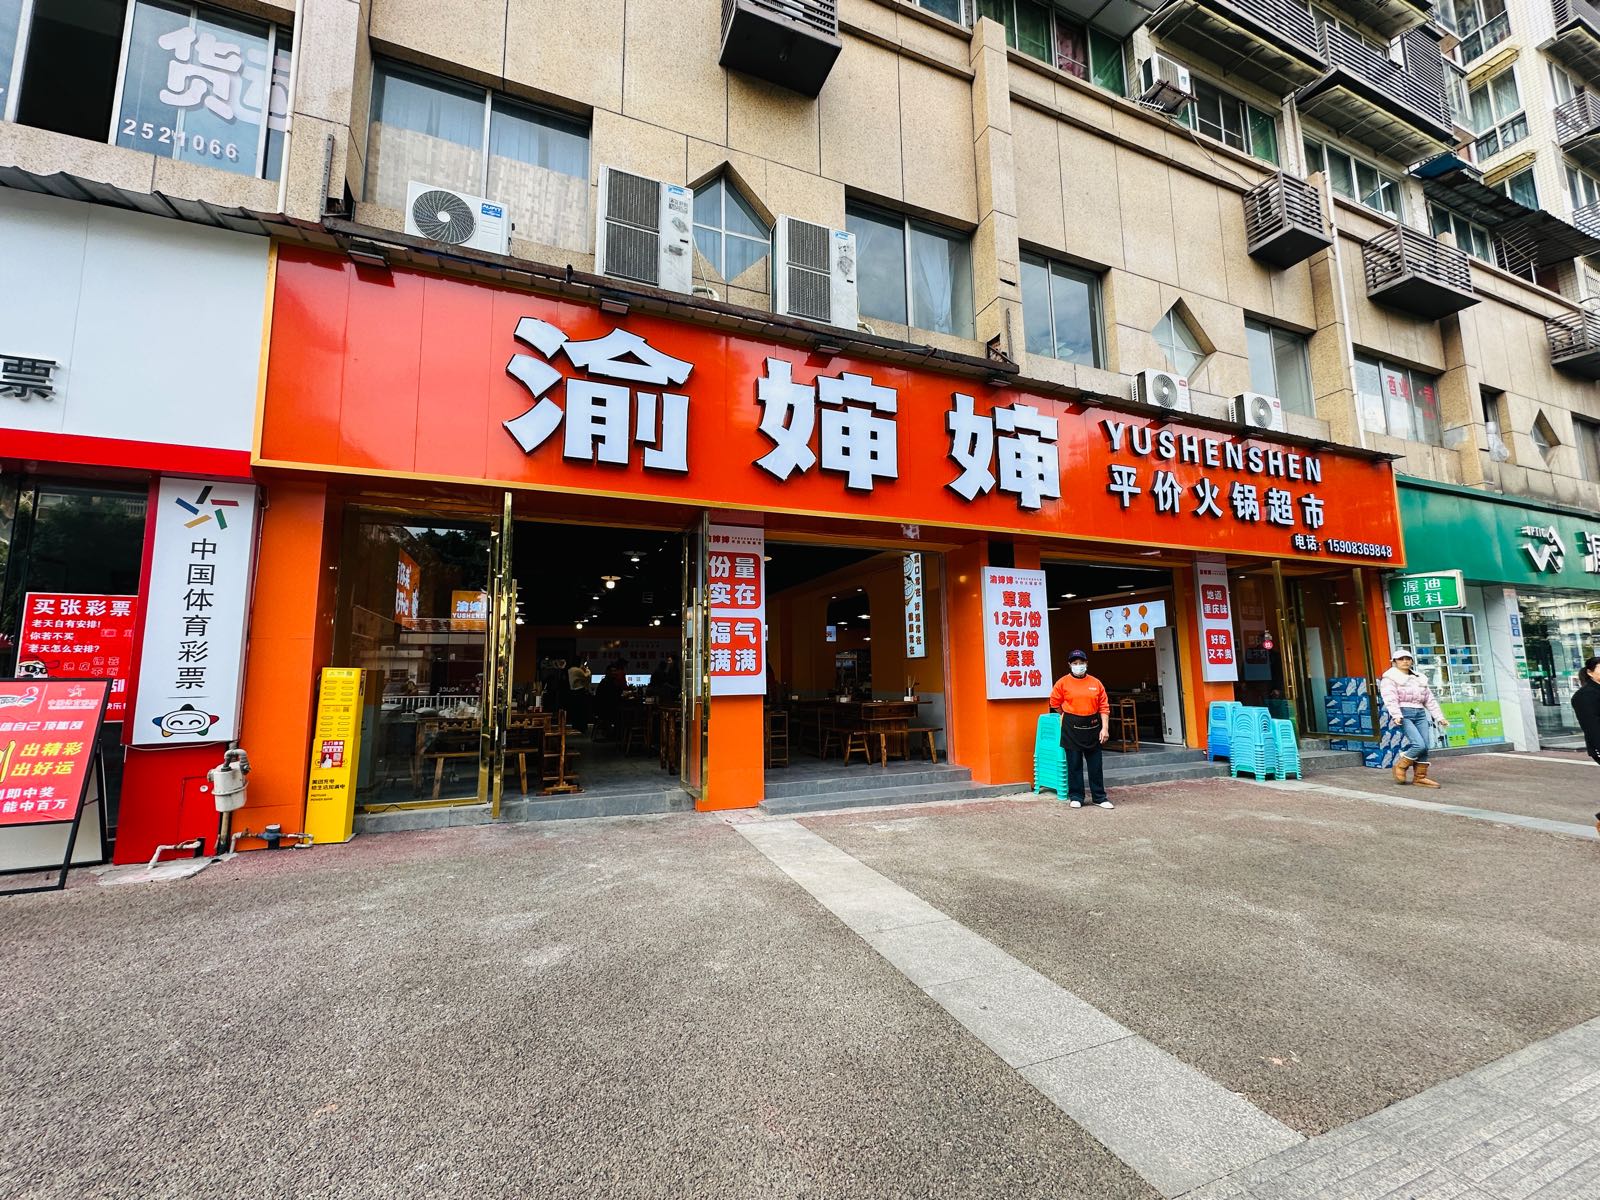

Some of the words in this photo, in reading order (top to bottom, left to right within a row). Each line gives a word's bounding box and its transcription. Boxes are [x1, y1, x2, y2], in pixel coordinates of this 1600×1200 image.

[122, 118, 241, 160] 2521066
[0, 354, 59, 400] 票
[502, 315, 1061, 511] 渝婶婶
[1102, 419, 1322, 483] YUSHENSHEN
[1108, 464, 1325, 529] 平价火锅超市
[709, 555, 756, 579] 份量
[709, 582, 756, 606] 实在
[1403, 577, 1442, 594] 渥迪
[33, 598, 132, 617] 买张彩票
[1403, 592, 1444, 606] 眼科
[175, 538, 217, 690] 中国体育彩票
[1203, 603, 1229, 615] 重庆味
[31, 619, 101, 629] 老天自有安排!
[993, 610, 1042, 628] 12元/份
[30, 631, 75, 641] 你若不买
[710, 621, 758, 645] 福气
[998, 630, 1040, 648] 8元/份
[1210, 634, 1228, 645] 好吃
[28, 644, 100, 653] 老天怎么安排?
[1208, 648, 1233, 660] 又不贵
[710, 649, 757, 672] 满满
[1005, 650, 1036, 667] 素菜
[1000, 669, 1042, 687] 4元/份
[20, 741, 84, 758] 出精彩
[10, 761, 75, 777] 出好运
[2, 798, 69, 813] 能中百万
